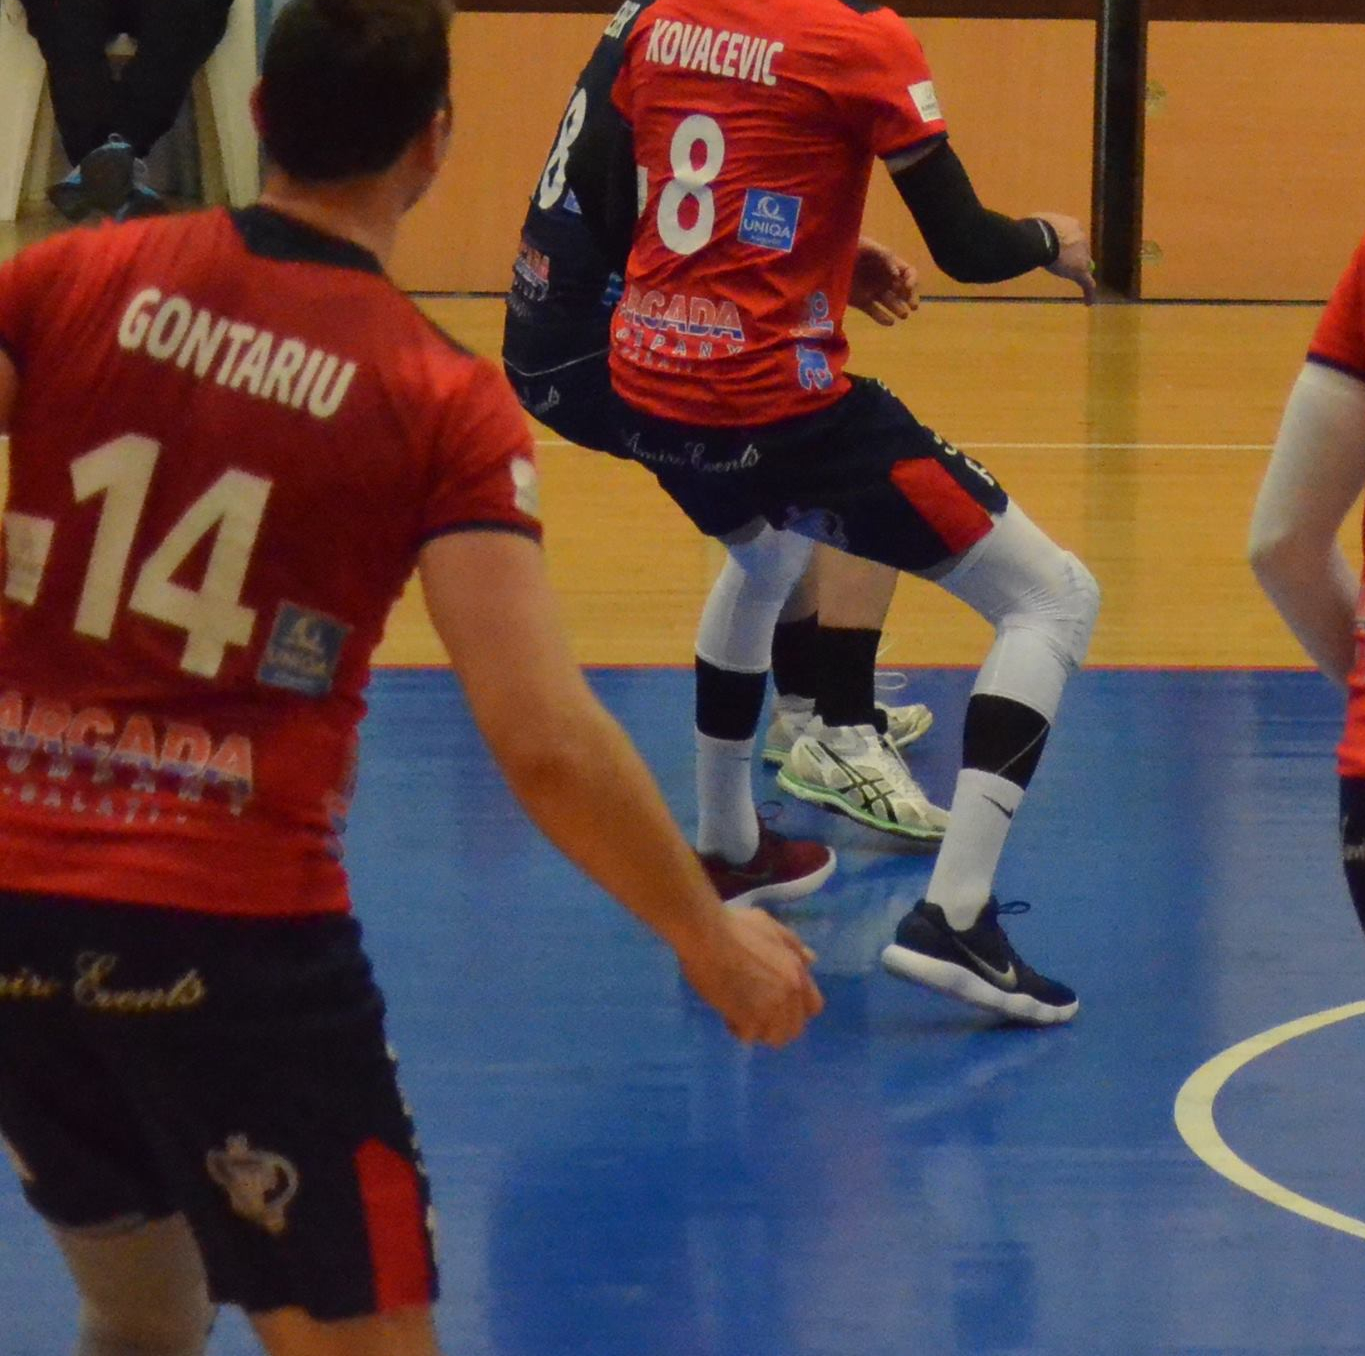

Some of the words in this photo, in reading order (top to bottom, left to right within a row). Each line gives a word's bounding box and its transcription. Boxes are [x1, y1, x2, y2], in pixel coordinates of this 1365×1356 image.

[645, 18, 784, 86] KOVACEVIC
[657, 114, 725, 255] 8
[743, 218, 791, 239] UNIQA
[118, 287, 356, 420] GONTARIU
[70, 432, 273, 680] 14
